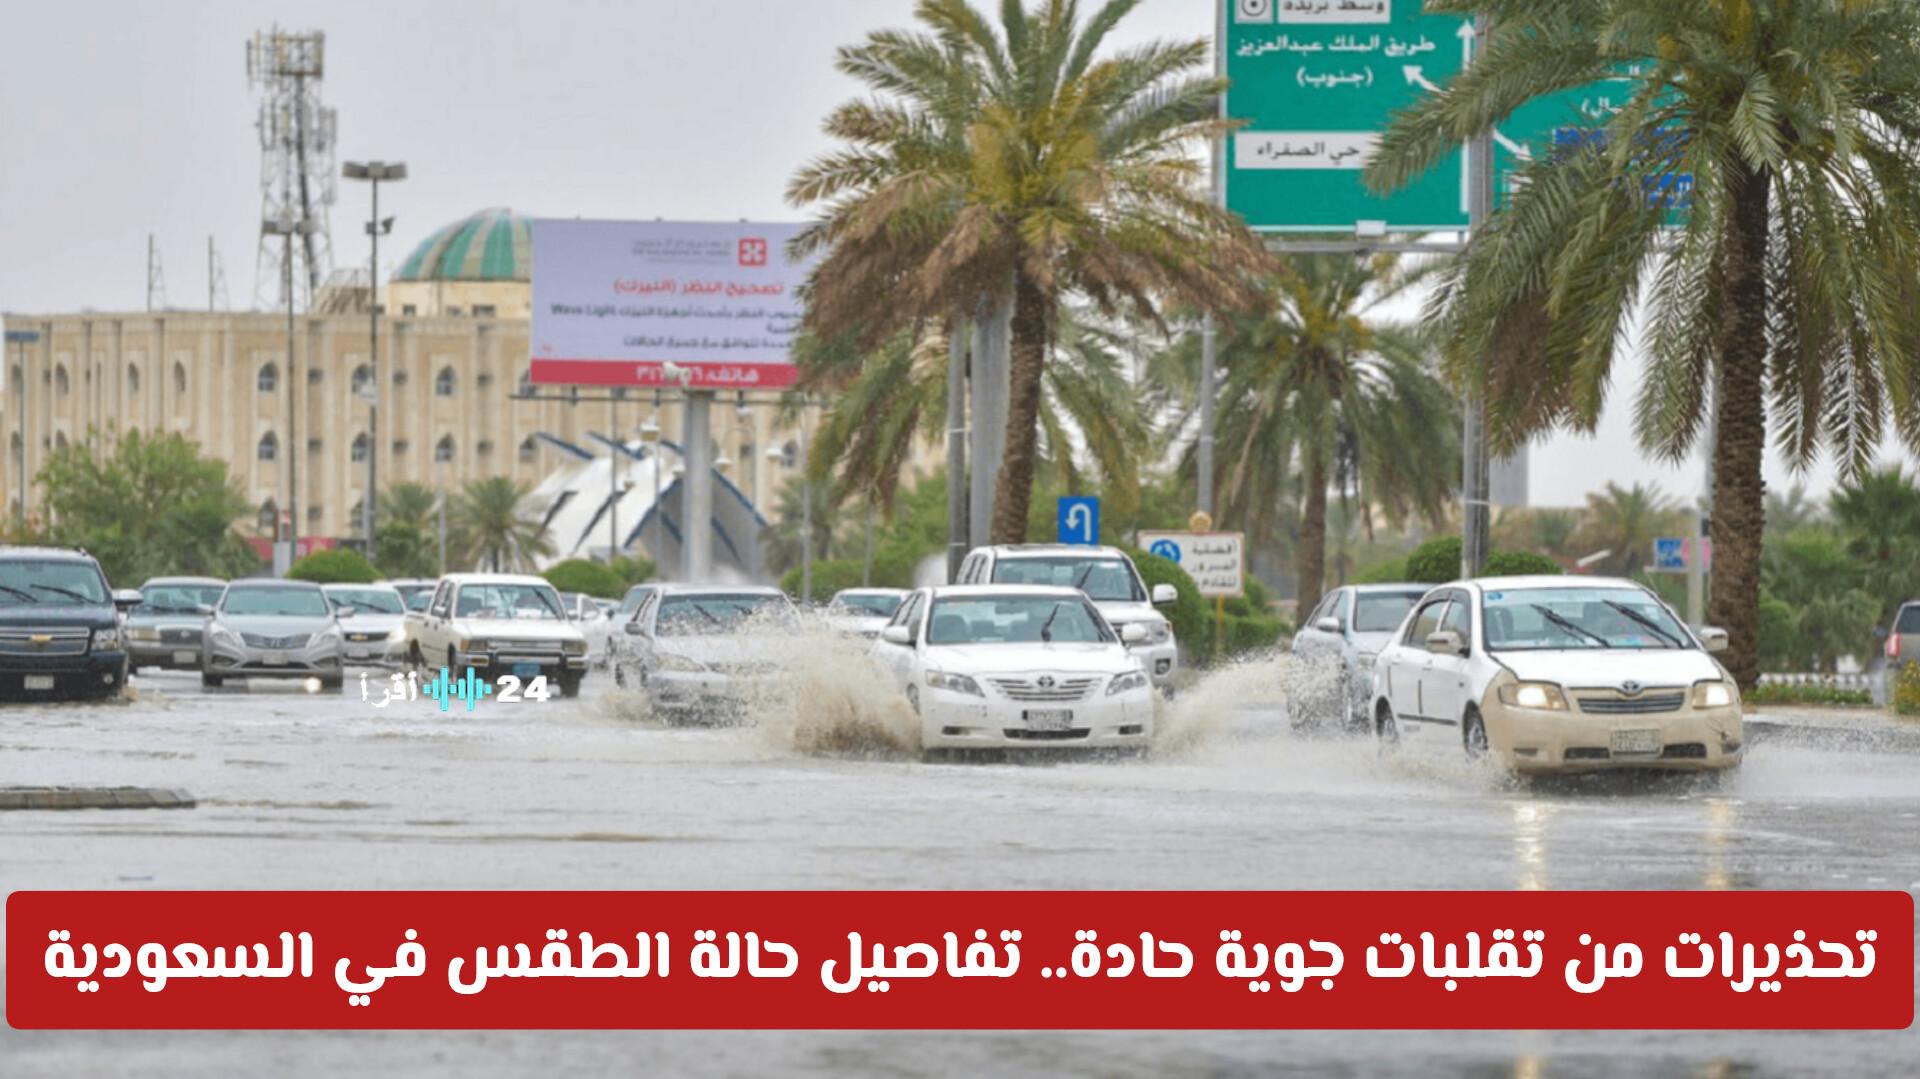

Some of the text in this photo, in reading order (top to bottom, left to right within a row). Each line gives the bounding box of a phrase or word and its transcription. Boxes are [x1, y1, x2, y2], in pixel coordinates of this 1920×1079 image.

[1237, 35, 1436, 57] طريق الملك عبدالعزيز
[1296, 66, 1374, 88] (جنوب)
[1257, 141, 1360, 166] حي الصفراء
[551, 303, 583, 316] Wave
